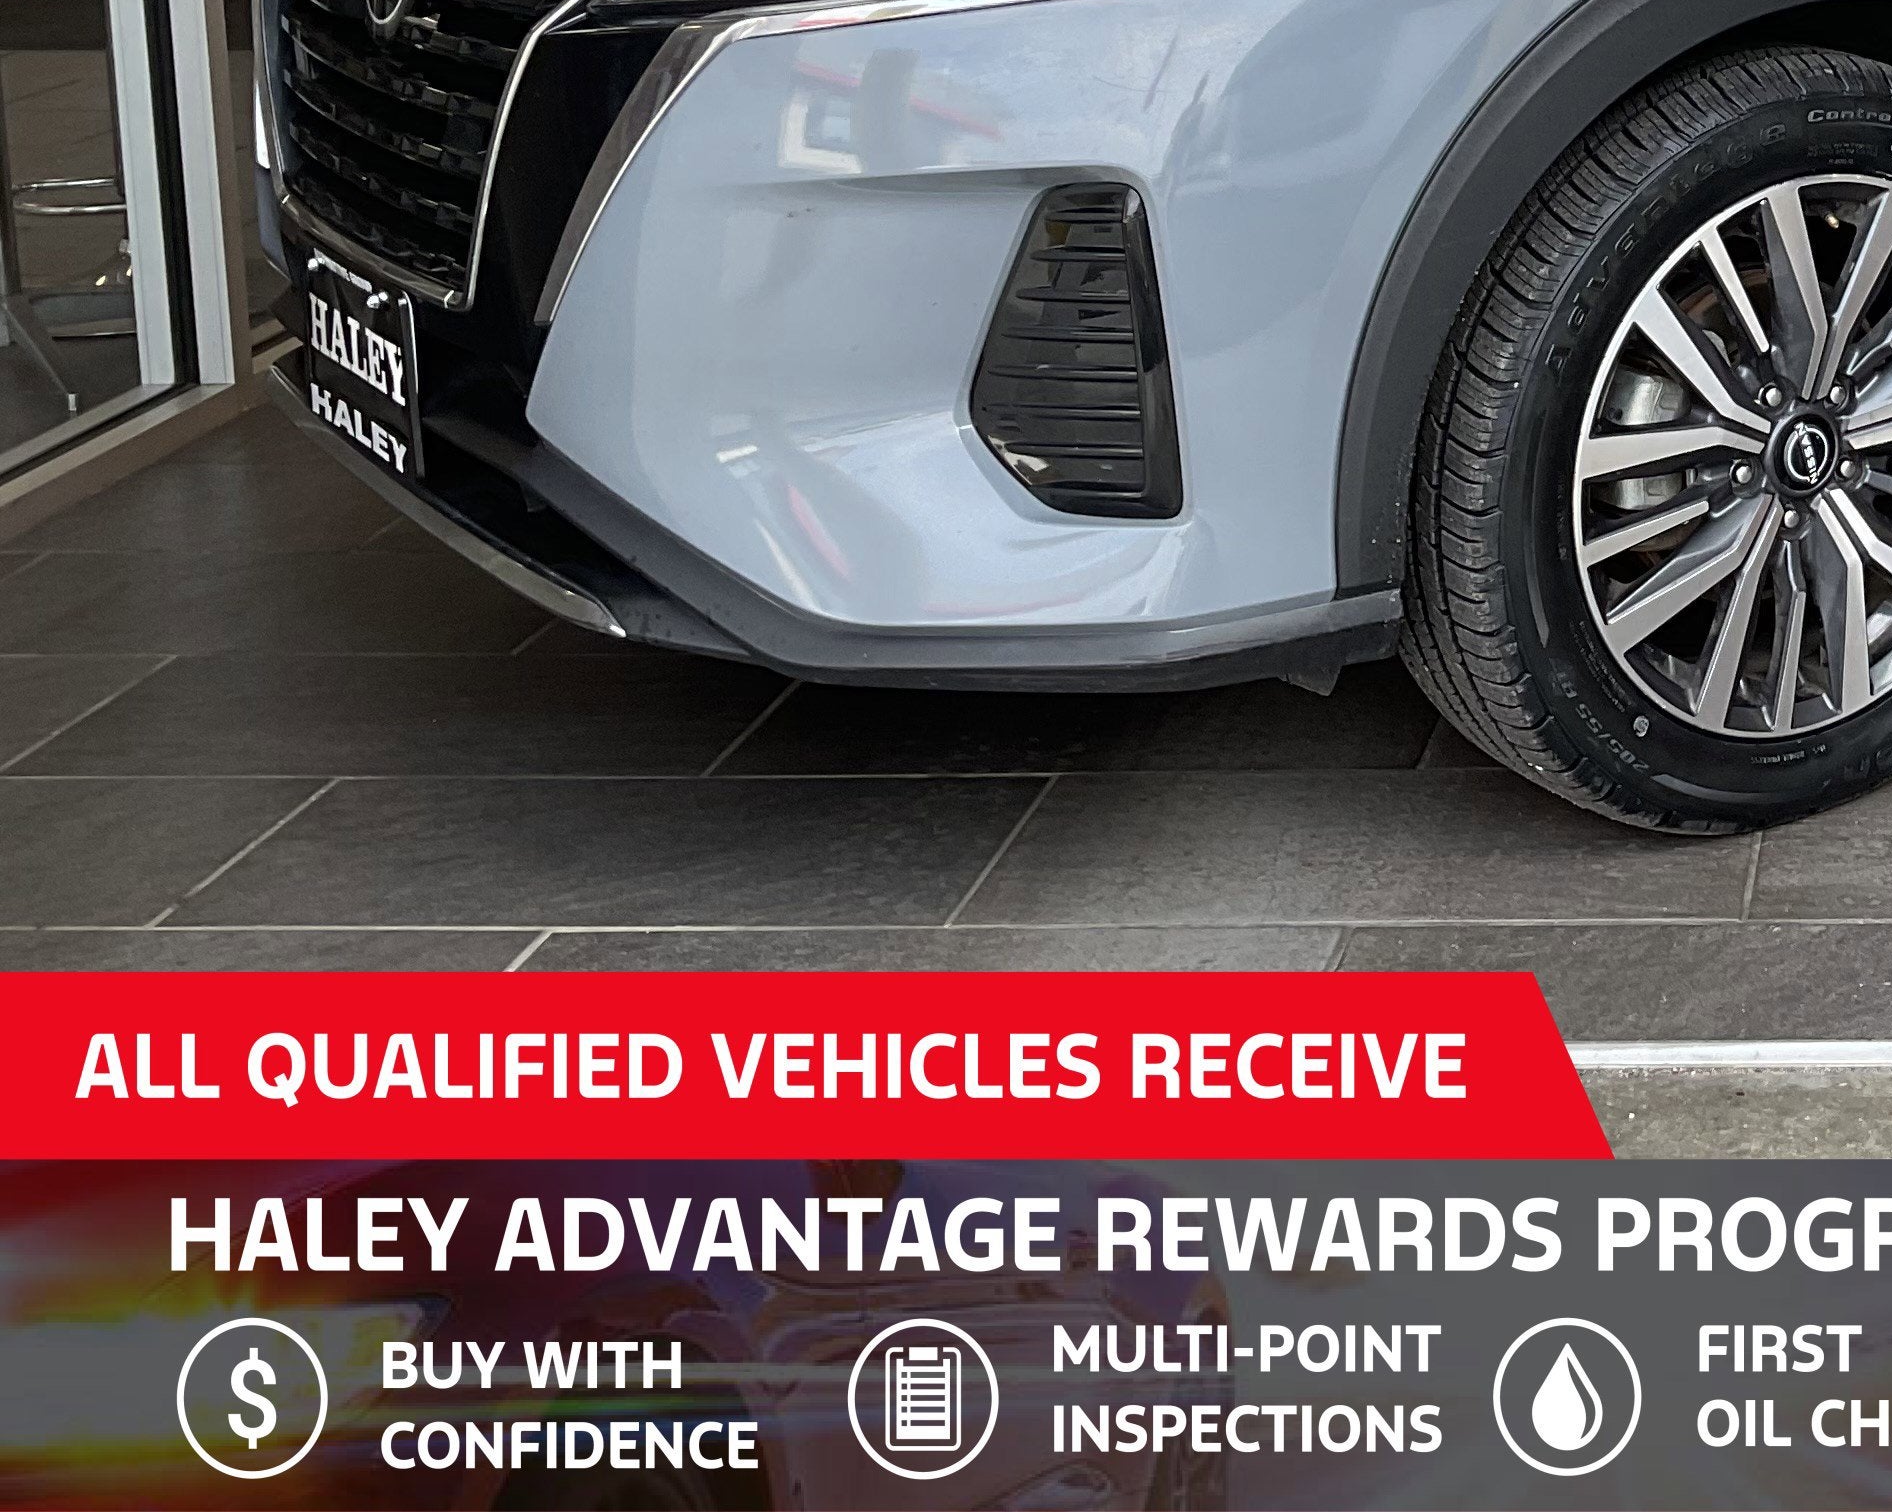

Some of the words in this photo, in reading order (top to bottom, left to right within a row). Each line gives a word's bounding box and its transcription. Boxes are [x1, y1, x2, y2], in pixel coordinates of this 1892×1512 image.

[308, 291, 406, 407] HALEY
[310, 382, 407, 474] HALEY
[1794, 421, 1819, 485] NISSAN
